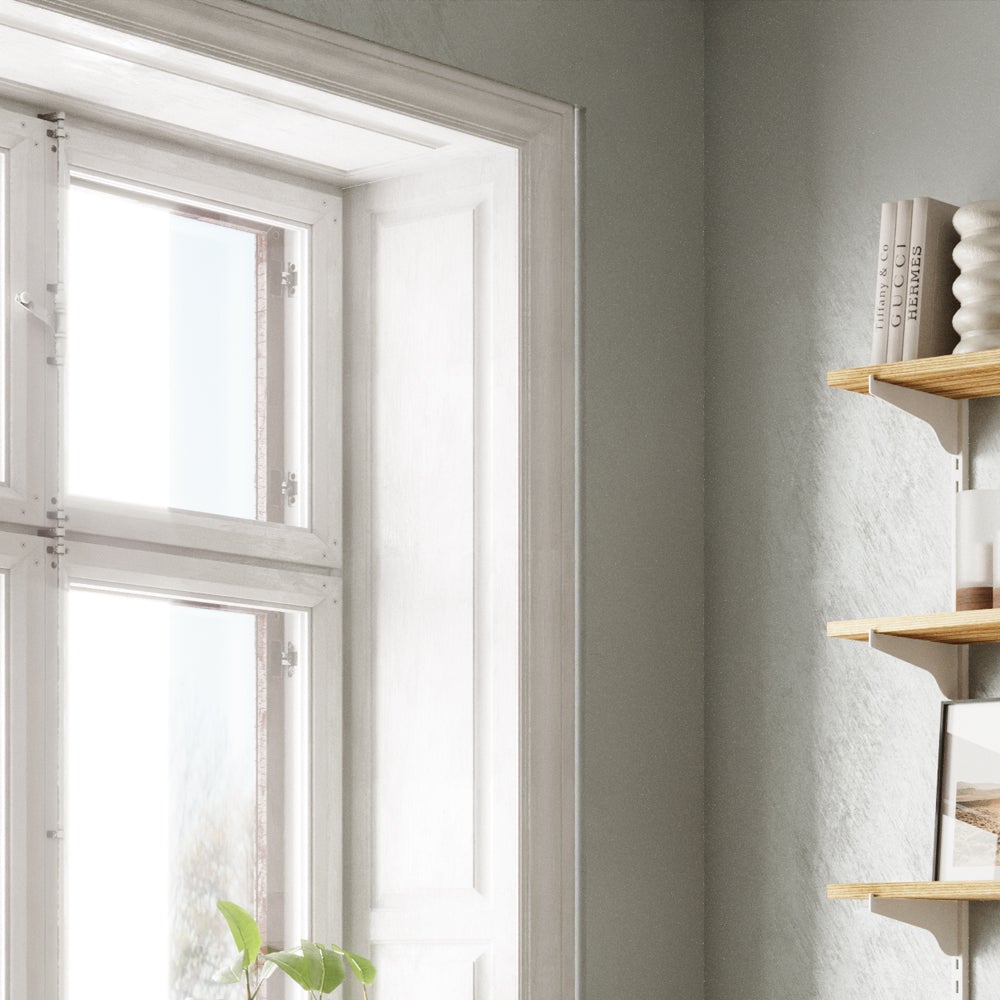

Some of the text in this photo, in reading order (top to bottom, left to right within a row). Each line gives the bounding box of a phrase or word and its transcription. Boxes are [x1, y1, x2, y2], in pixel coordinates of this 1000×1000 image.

[876, 283, 889, 329] Tiffany
[891, 244, 906, 328] GUCCI
[908, 246, 922, 320] HERMES
